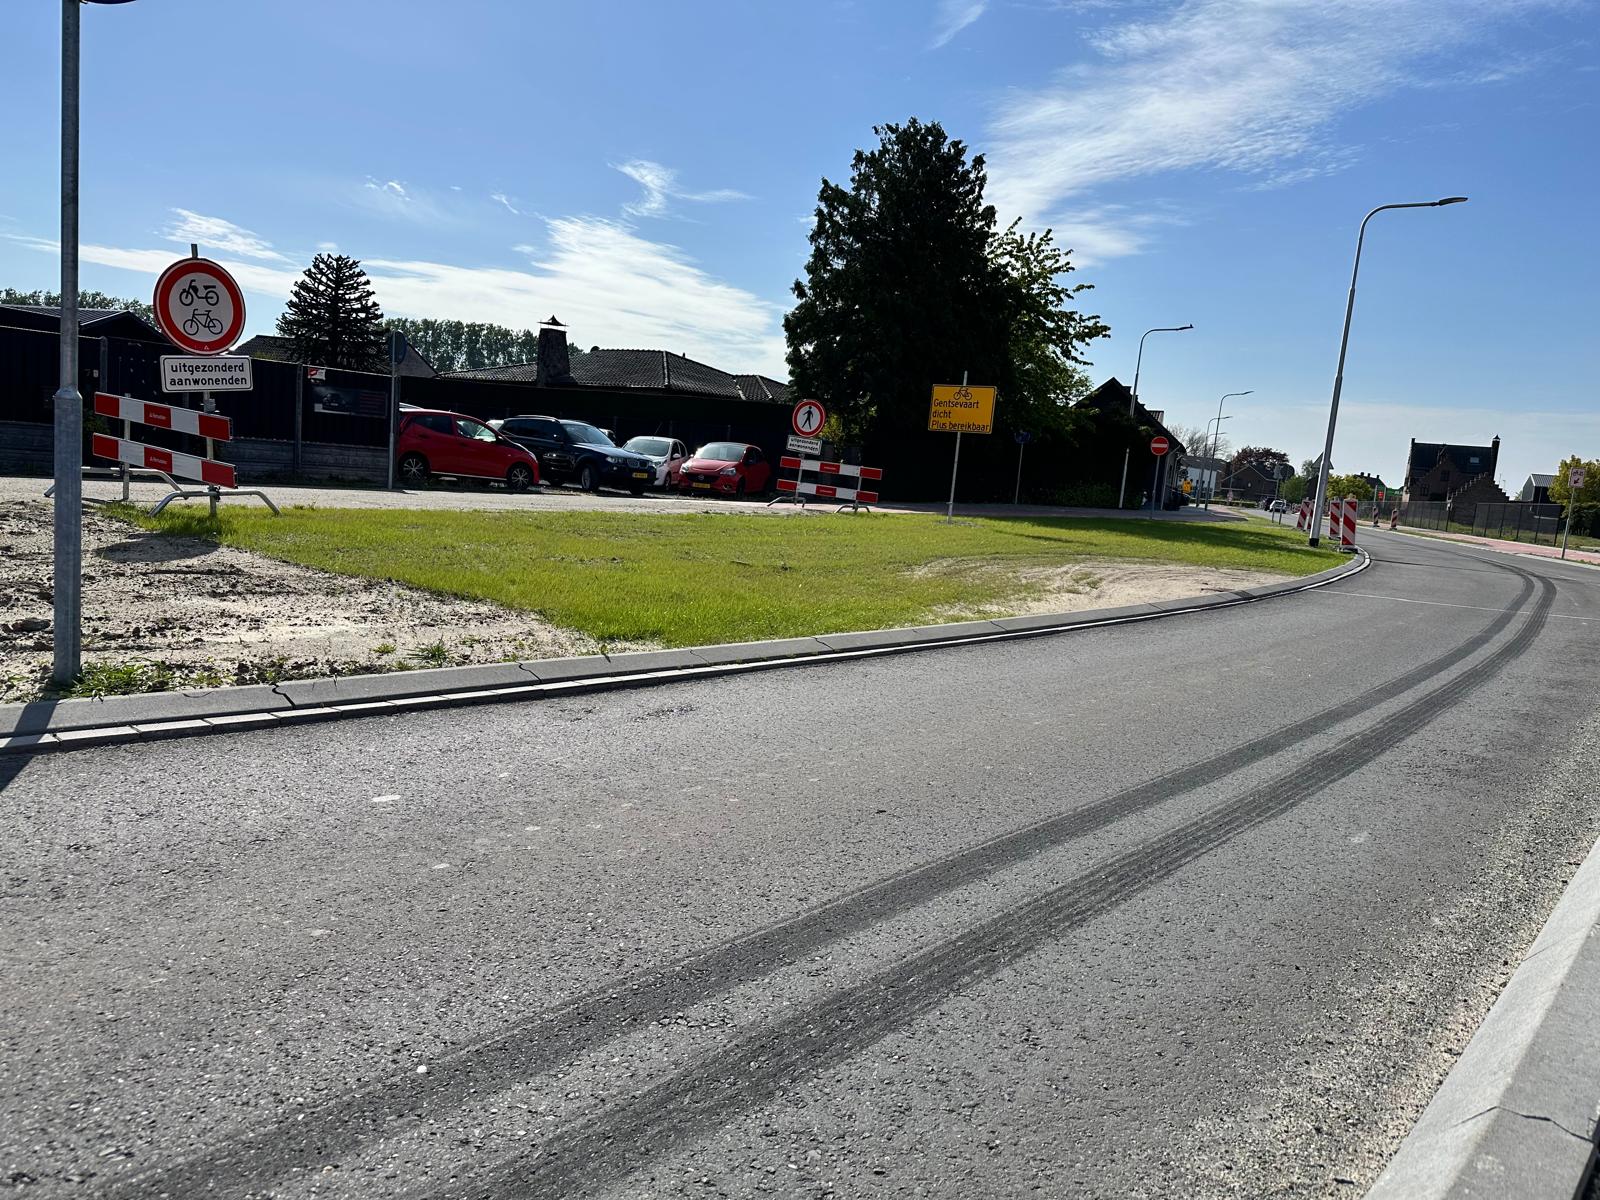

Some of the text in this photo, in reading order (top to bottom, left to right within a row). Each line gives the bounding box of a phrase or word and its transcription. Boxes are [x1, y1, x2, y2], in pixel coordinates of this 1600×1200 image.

[170, 362, 245, 376] uitgezonderd
[169, 375, 248, 386] aanwonenden
[933, 398, 980, 409] Gentsevaart
[932, 409, 952, 419] dicht
[931, 419, 990, 432] Plus bereikbaar
